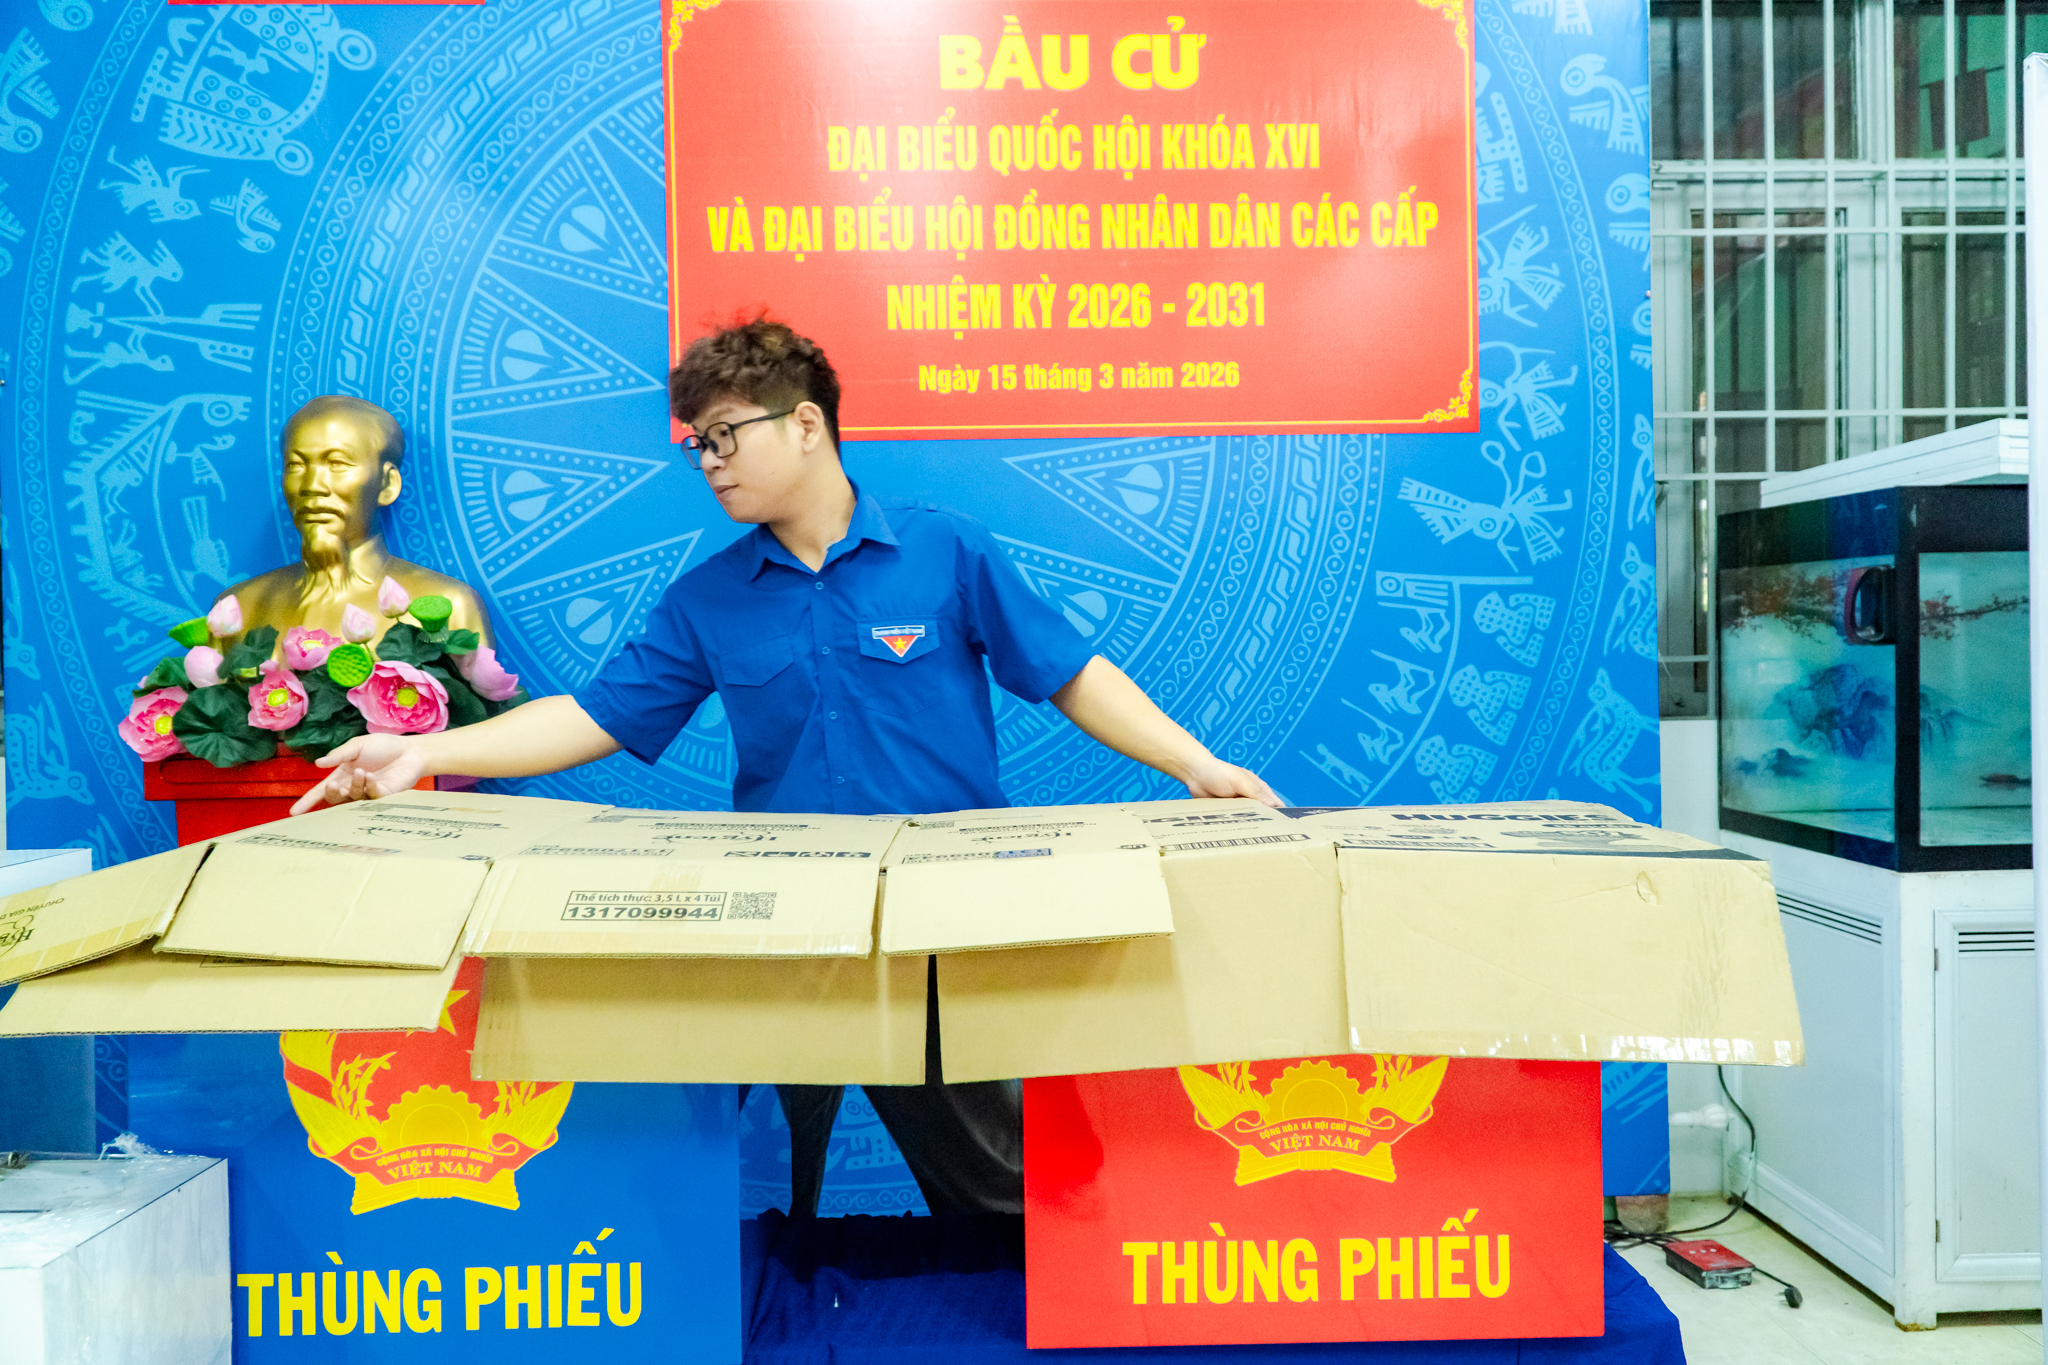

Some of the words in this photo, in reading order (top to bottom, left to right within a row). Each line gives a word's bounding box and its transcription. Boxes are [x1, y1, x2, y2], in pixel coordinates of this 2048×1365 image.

[939, 15, 1090, 90] BẦU
[1112, 16, 1207, 90] CỬ
[827, 126, 887, 181] ĐẠI
[898, 106, 977, 171] BIỂU
[989, 108, 1082, 176] QUỐC
[1093, 115, 1151, 180] HỘI
[1162, 114, 1256, 170] KHÓA
[1265, 123, 1319, 169] XVI
[706, 196, 754, 252] VÀ
[763, 206, 822, 262] ĐẠI
[834, 187, 914, 251] BIỂU
[925, 195, 983, 261] HỘI
[994, 189, 1090, 249] ĐỒNG
[1101, 194, 1198, 249] NHÂN
[1209, 193, 1281, 248] DÂN
[1291, 192, 1359, 248] CÁC
[1371, 186, 1439, 247] CẤP
[887, 275, 1001, 339] NHIỆM
[1013, 274, 1057, 329] KỲ
[1067, 283, 1151, 328] 2026
[1162, 303, 1176, 313] -
[1186, 282, 1265, 327] 2031
[918, 364, 980, 393] Ngày
[988, 365, 1017, 390] 15
[1024, 363, 1092, 392] tháng
[1099, 363, 1114, 389] 3
[1122, 362, 1174, 389] năm
[1181, 362, 1241, 388] 2026
[1391, 813, 1619, 822] HUGGIES
[598, 893, 620, 902] tích
[654, 894, 673, 904] 3,5
[676, 894, 682, 902] L
[694, 894, 701, 902] 4
[704, 894, 721, 902] Túi
[567, 906, 718, 919] 1317099944
[1259, 1129, 1281, 1139] CỘNG
[1282, 1123, 1299, 1133] HÒA
[1301, 1121, 1312, 1130] XÃ
[1314, 1121, 1329, 1131] HỘI
[1330, 1122, 1347, 1131] CHỦ
[1348, 1125, 1371, 1137] NGHĨA
[1269, 1133, 1313, 1152] VIỆT
[1319, 1135, 1361, 1151] NAM
[376, 1154, 399, 1167] CỘNG
[400, 1150, 418, 1160] HÒA
[420, 1147, 432, 1156] XÃ
[434, 1147, 448, 1157] HỘI
[450, 1148, 467, 1158] CHỦ
[469, 1151, 494, 1164] NGHĨA
[386, 1160, 433, 1179] VIỆT
[438, 1161, 483, 1178] NAM
[1122, 1222, 1319, 1305] THÙNG
[1339, 1208, 1511, 1301] PHIẾU
[237, 1251, 442, 1337] THÙNG
[465, 1227, 642, 1331] PHIẾU
